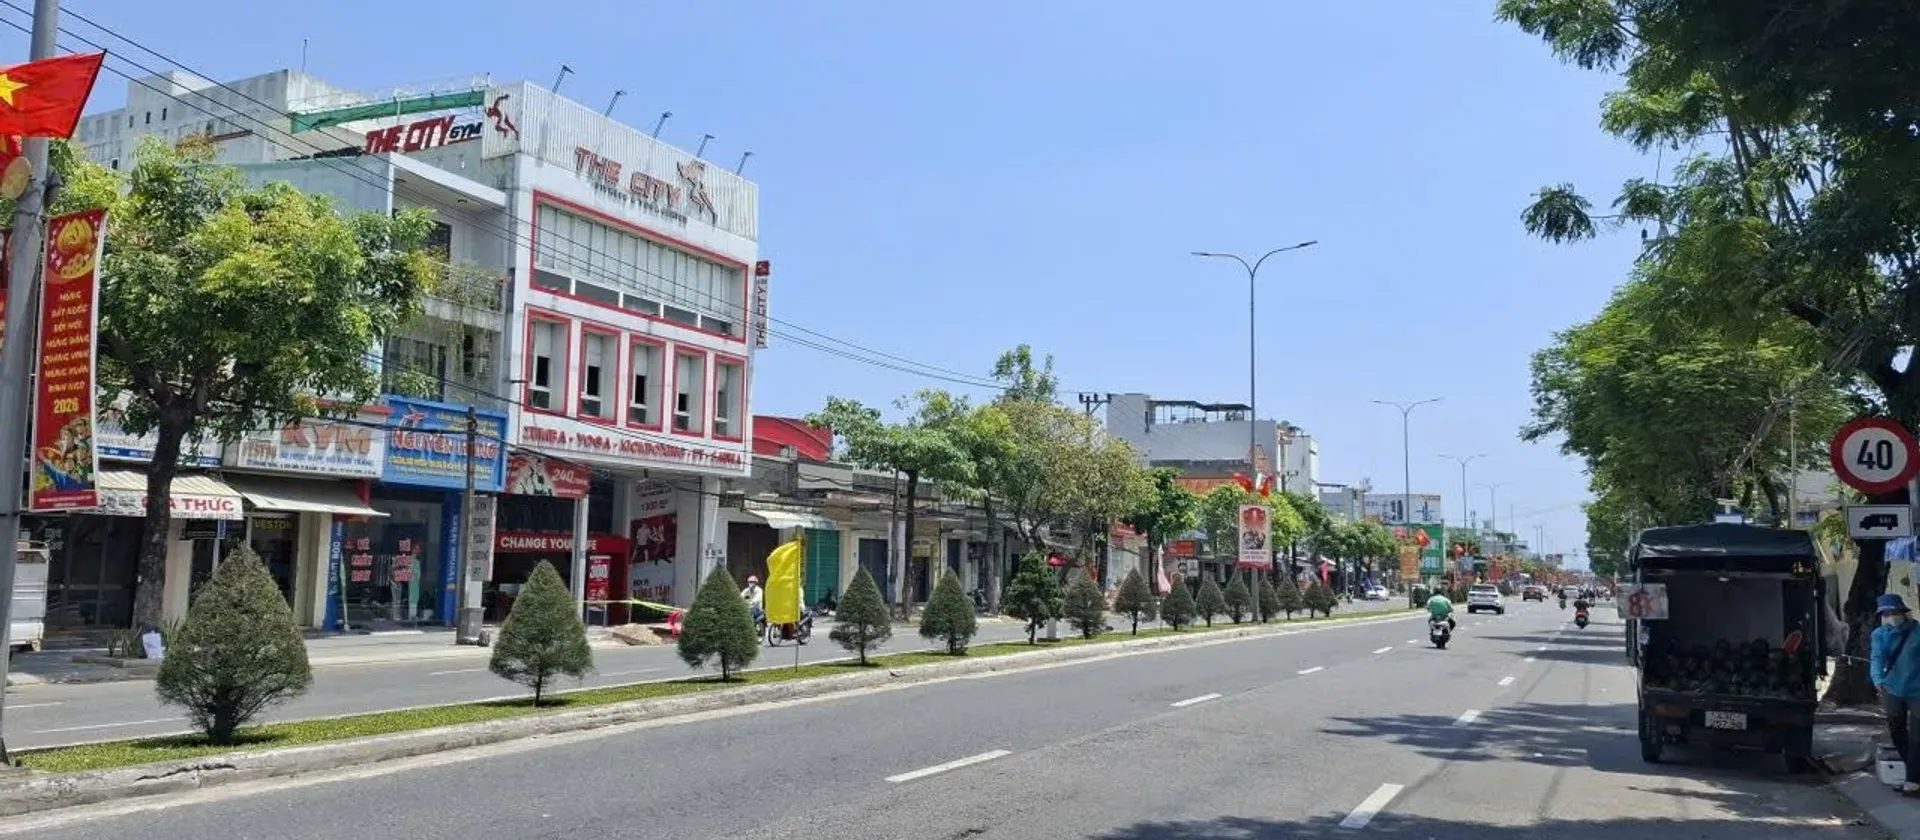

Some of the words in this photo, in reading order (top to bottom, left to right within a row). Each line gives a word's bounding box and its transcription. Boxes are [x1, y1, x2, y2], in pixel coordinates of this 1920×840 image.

[366, 125, 403, 154] THE
[404, 114, 456, 152] CITY
[450, 122, 482, 138] GYM
[575, 146, 622, 185] THE
[631, 171, 681, 205] CITY
[757, 287, 766, 316] CITY
[756, 322, 765, 346] THE
[54, 397, 79, 414] 2026
[523, 426, 567, 444] ZUMBA
[576, 432, 612, 450] YOGA
[1857, 440, 1893, 470] 40
[552, 468, 574, 482] 240
[500, 537, 547, 549] CHANGE
